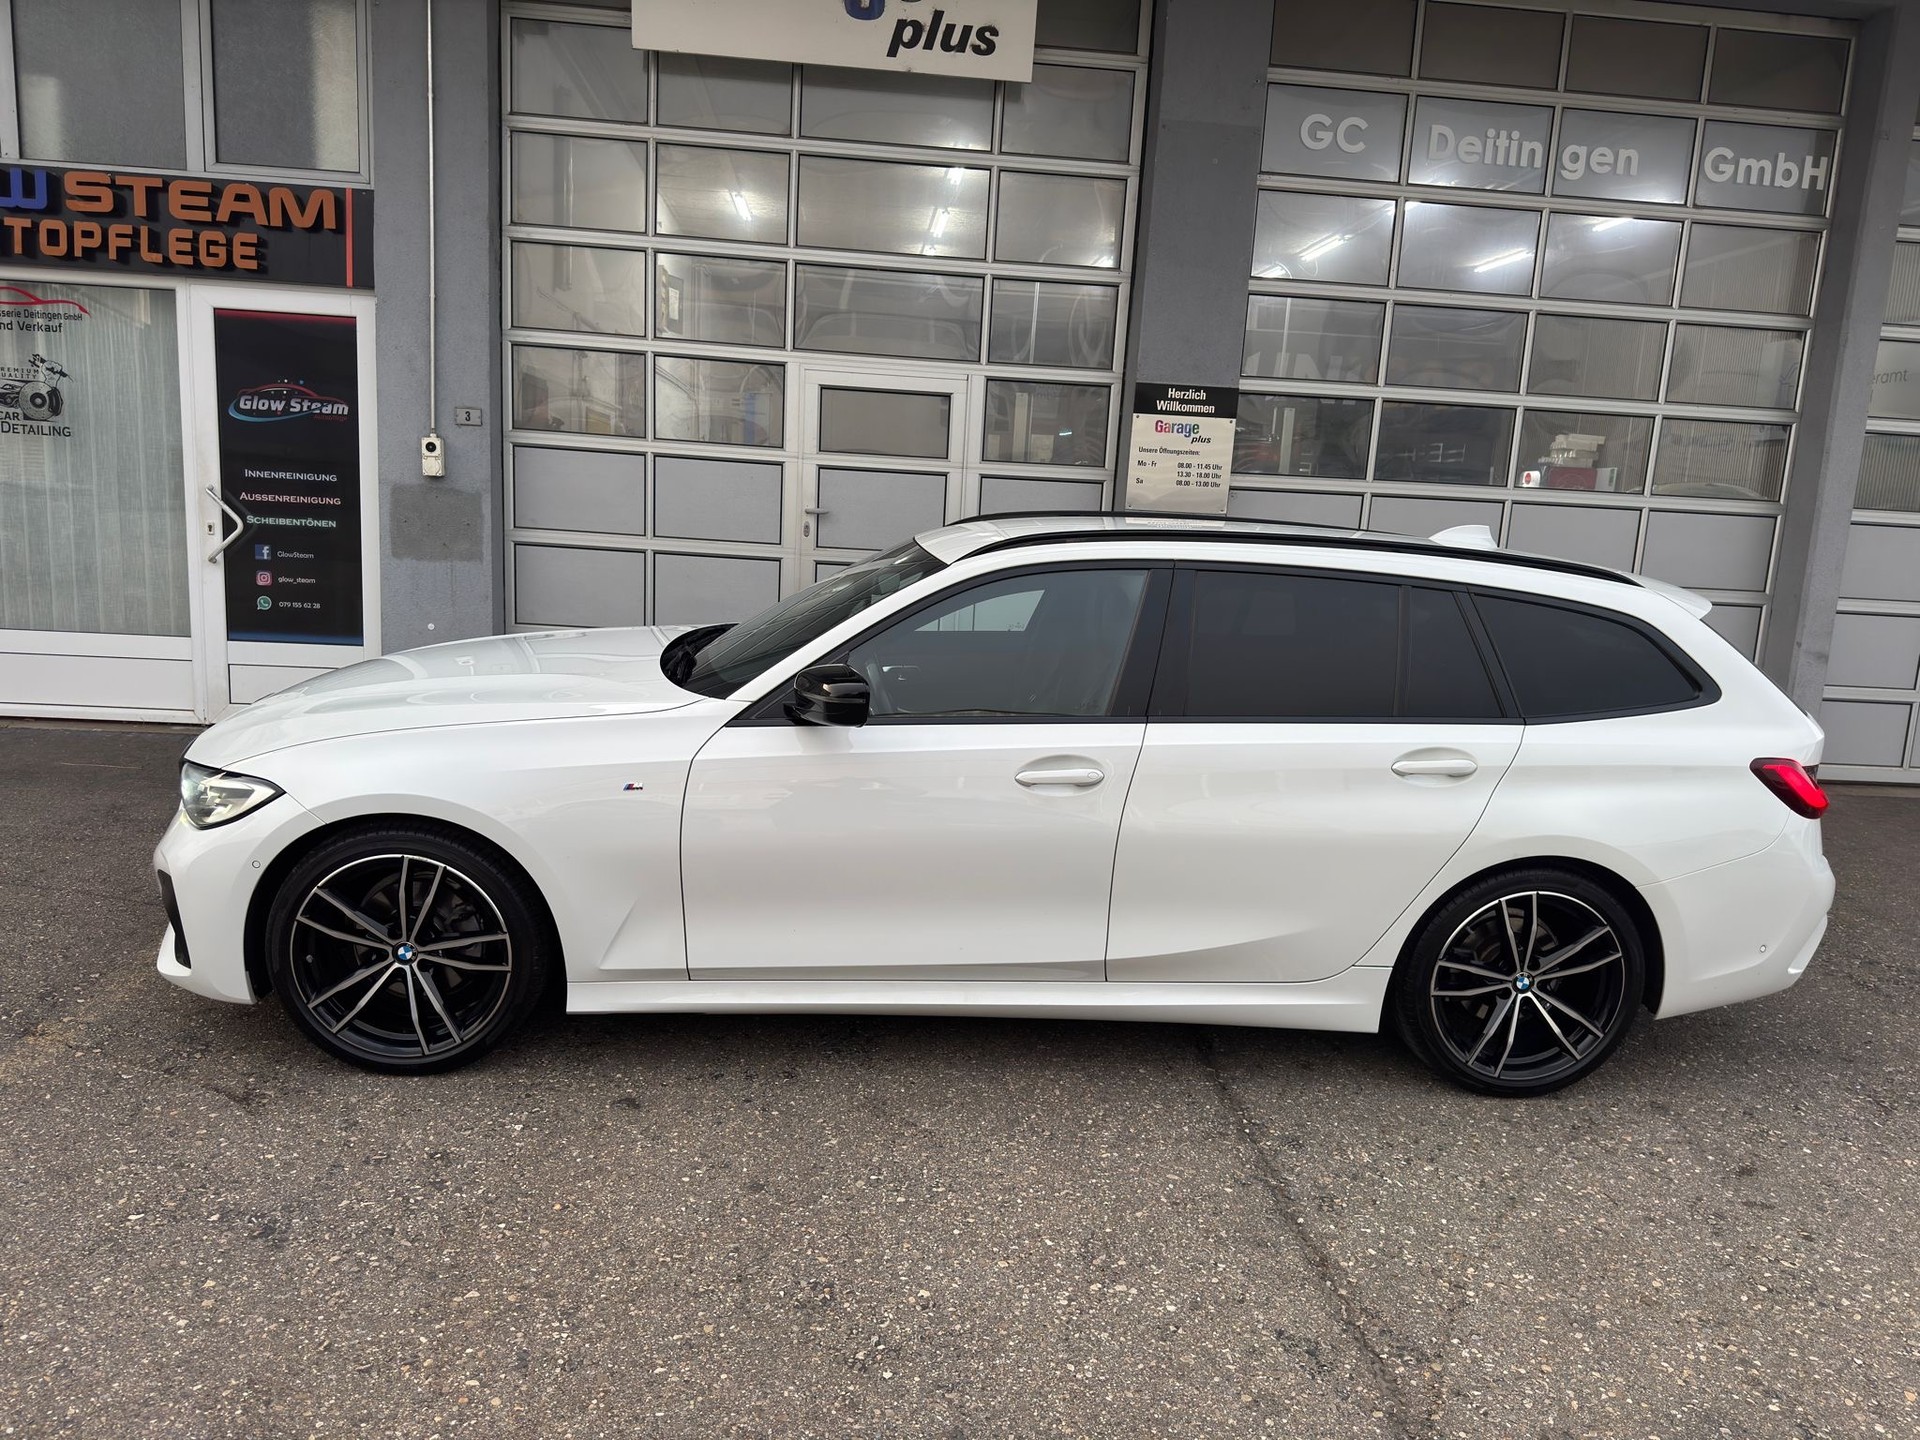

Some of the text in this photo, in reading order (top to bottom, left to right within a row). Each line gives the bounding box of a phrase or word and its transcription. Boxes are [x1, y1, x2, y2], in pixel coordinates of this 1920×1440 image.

[886, 9, 999, 58] plus
[1300, 113, 1369, 154] GC
[1703, 146, 1829, 191] GmbH
[64, 171, 337, 230] STEAM
[23, 309, 62, 322] Deitingen
[17, 320, 63, 333] Verkauf
[1168, 388, 1206, 400] Herzlich
[239, 395, 349, 415] Glow Steam
[1156, 400, 1215, 413] Willkommen
[465, 411, 471, 422] 3
[1, 420, 71, 438] DETAILING
[1155, 419, 1200, 438] Garage
[1191, 435, 1212, 444] plus
[1138, 446, 1158, 454] Unsere
[244, 469, 337, 482] INNENREINIGUNG
[240, 492, 341, 505] AUSSENREINIGUNG
[246, 515, 337, 528] SCHEIBENTÖNEN
